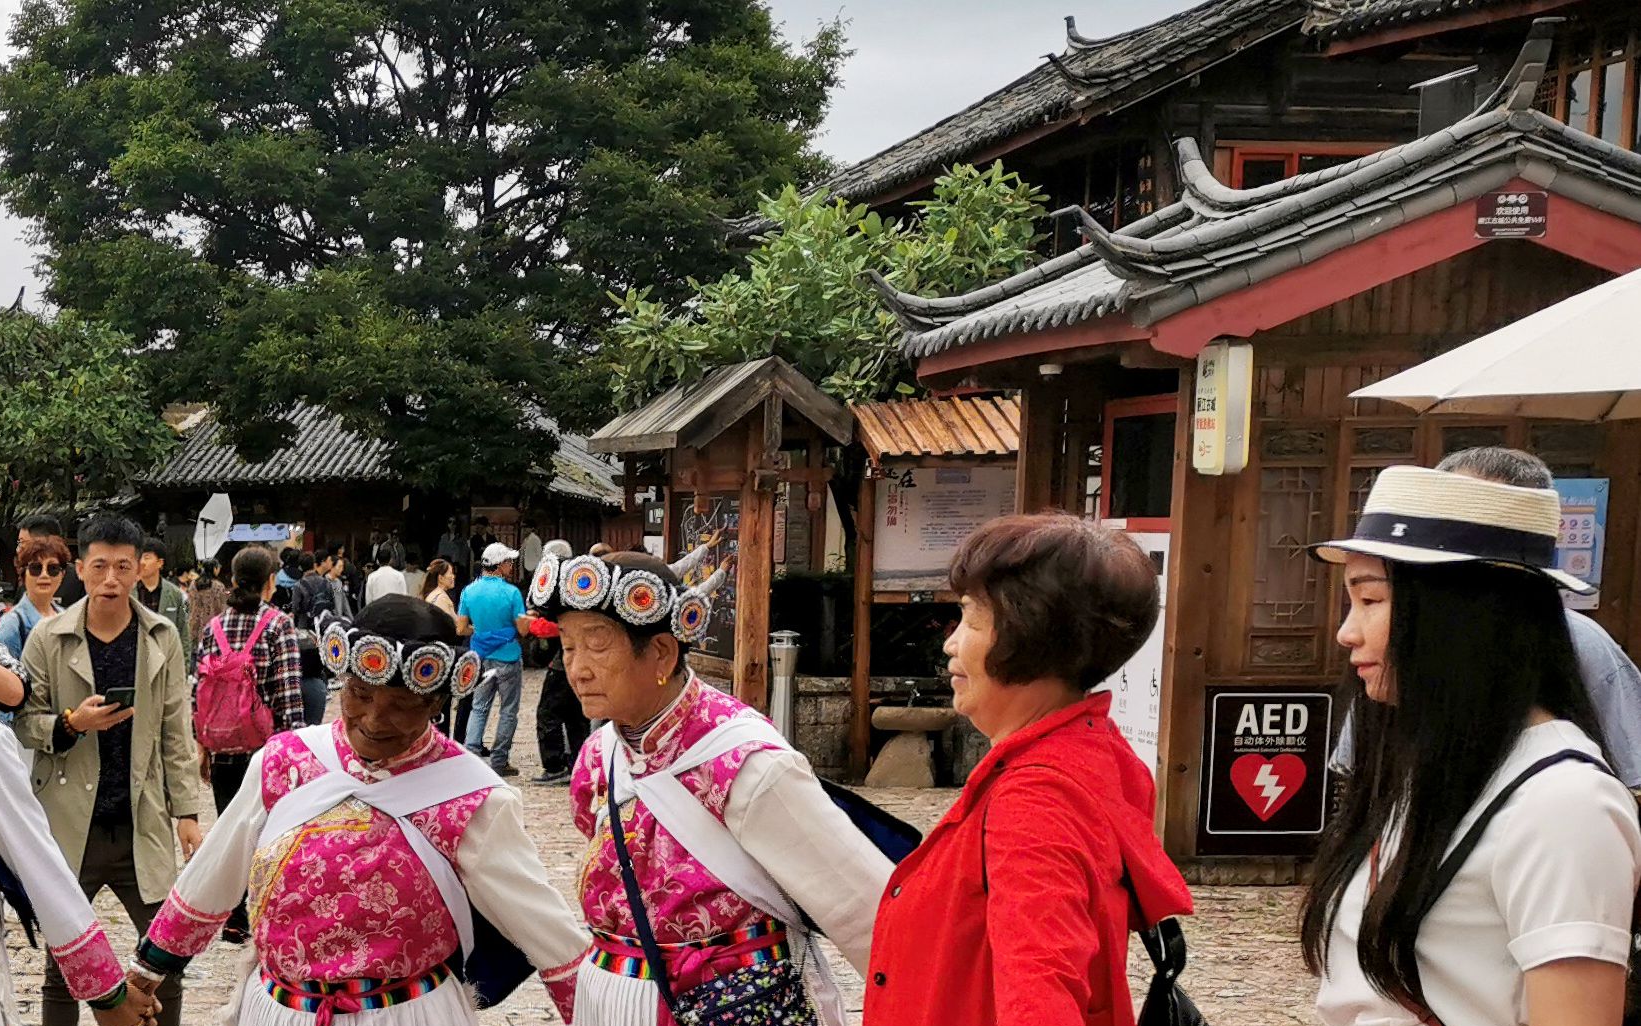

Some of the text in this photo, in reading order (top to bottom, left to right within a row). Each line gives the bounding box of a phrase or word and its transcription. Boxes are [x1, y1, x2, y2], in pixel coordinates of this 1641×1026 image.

[1235, 703, 1308, 736] AED
[1234, 736, 1307, 746] 自动体外除颤仪
